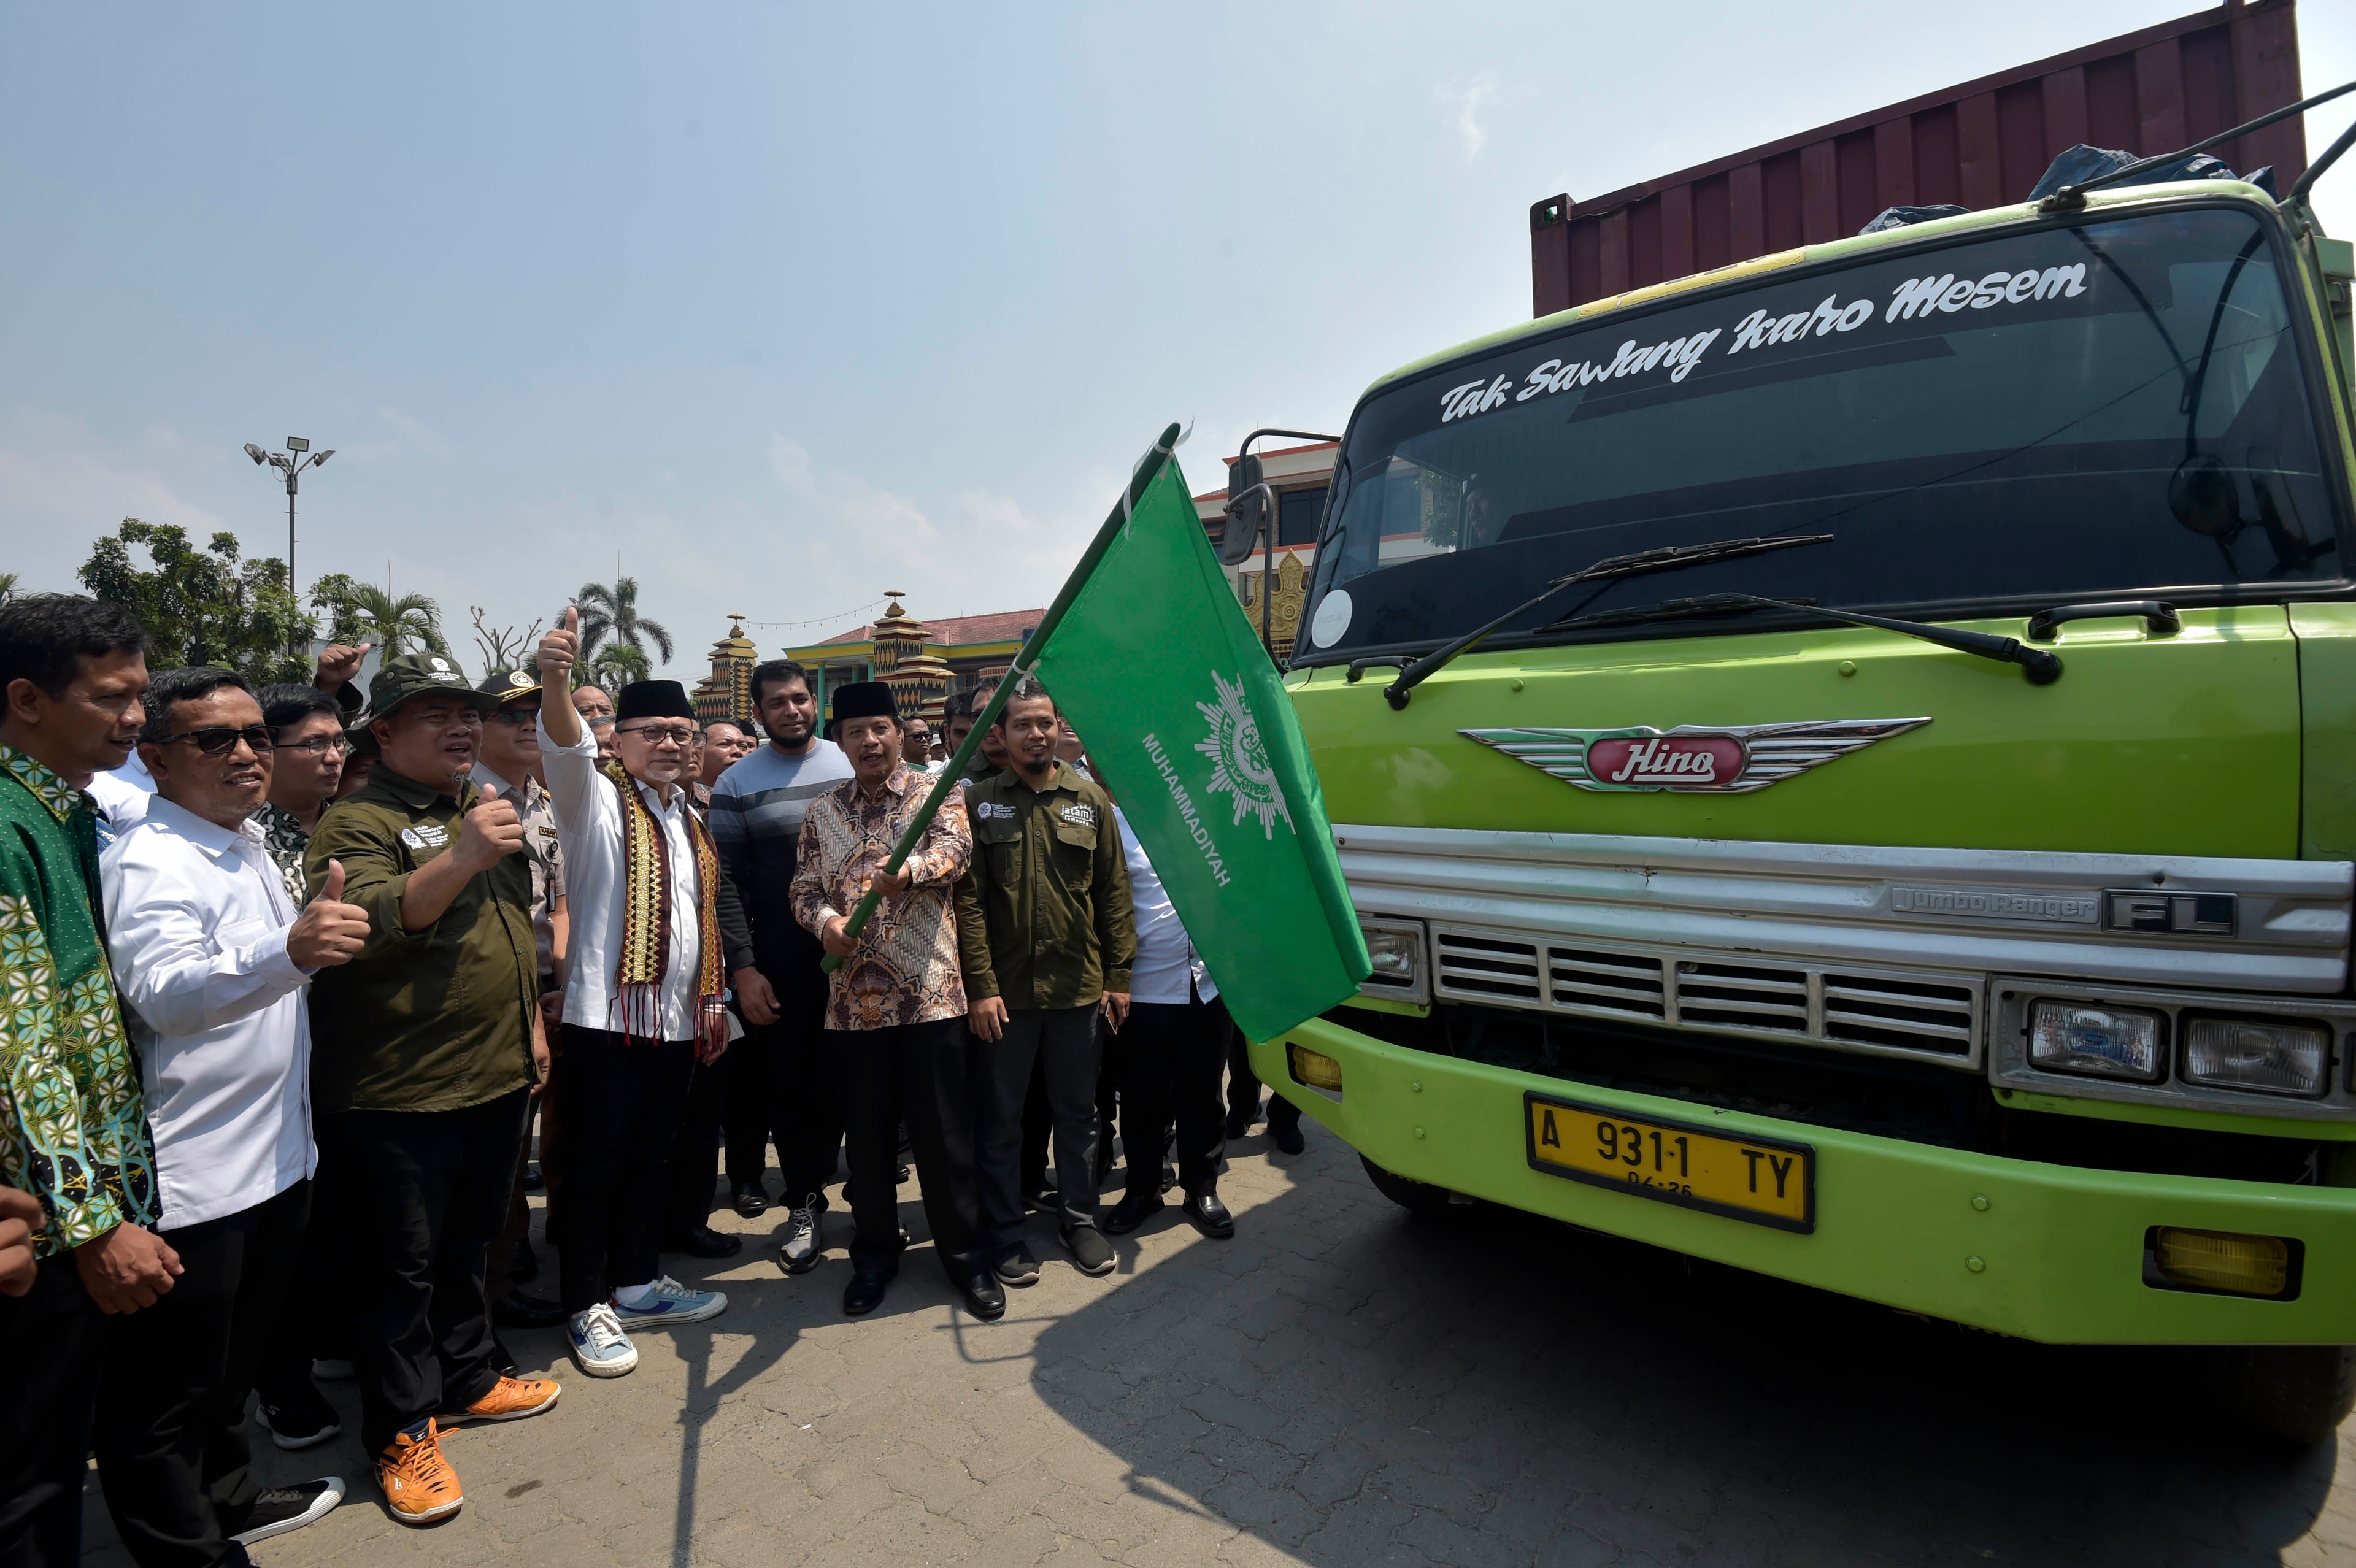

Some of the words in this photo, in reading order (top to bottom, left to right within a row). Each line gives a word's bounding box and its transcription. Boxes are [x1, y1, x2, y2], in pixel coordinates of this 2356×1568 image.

[1441, 374, 1512, 423] Tak
[1885, 262, 2088, 323] Mesem
[1611, 739, 1715, 782] Hino
[1142, 732, 1231, 888] MUHAMMADIYAH
[1893, 888, 1985, 911] Jumbo
[1992, 894, 2095, 920] Ranger
[2110, 894, 2231, 932] FL
[1542, 1109, 1561, 1148] A
[1596, 1121, 1688, 1177] 9311
[1741, 1148, 1793, 1199] TY
